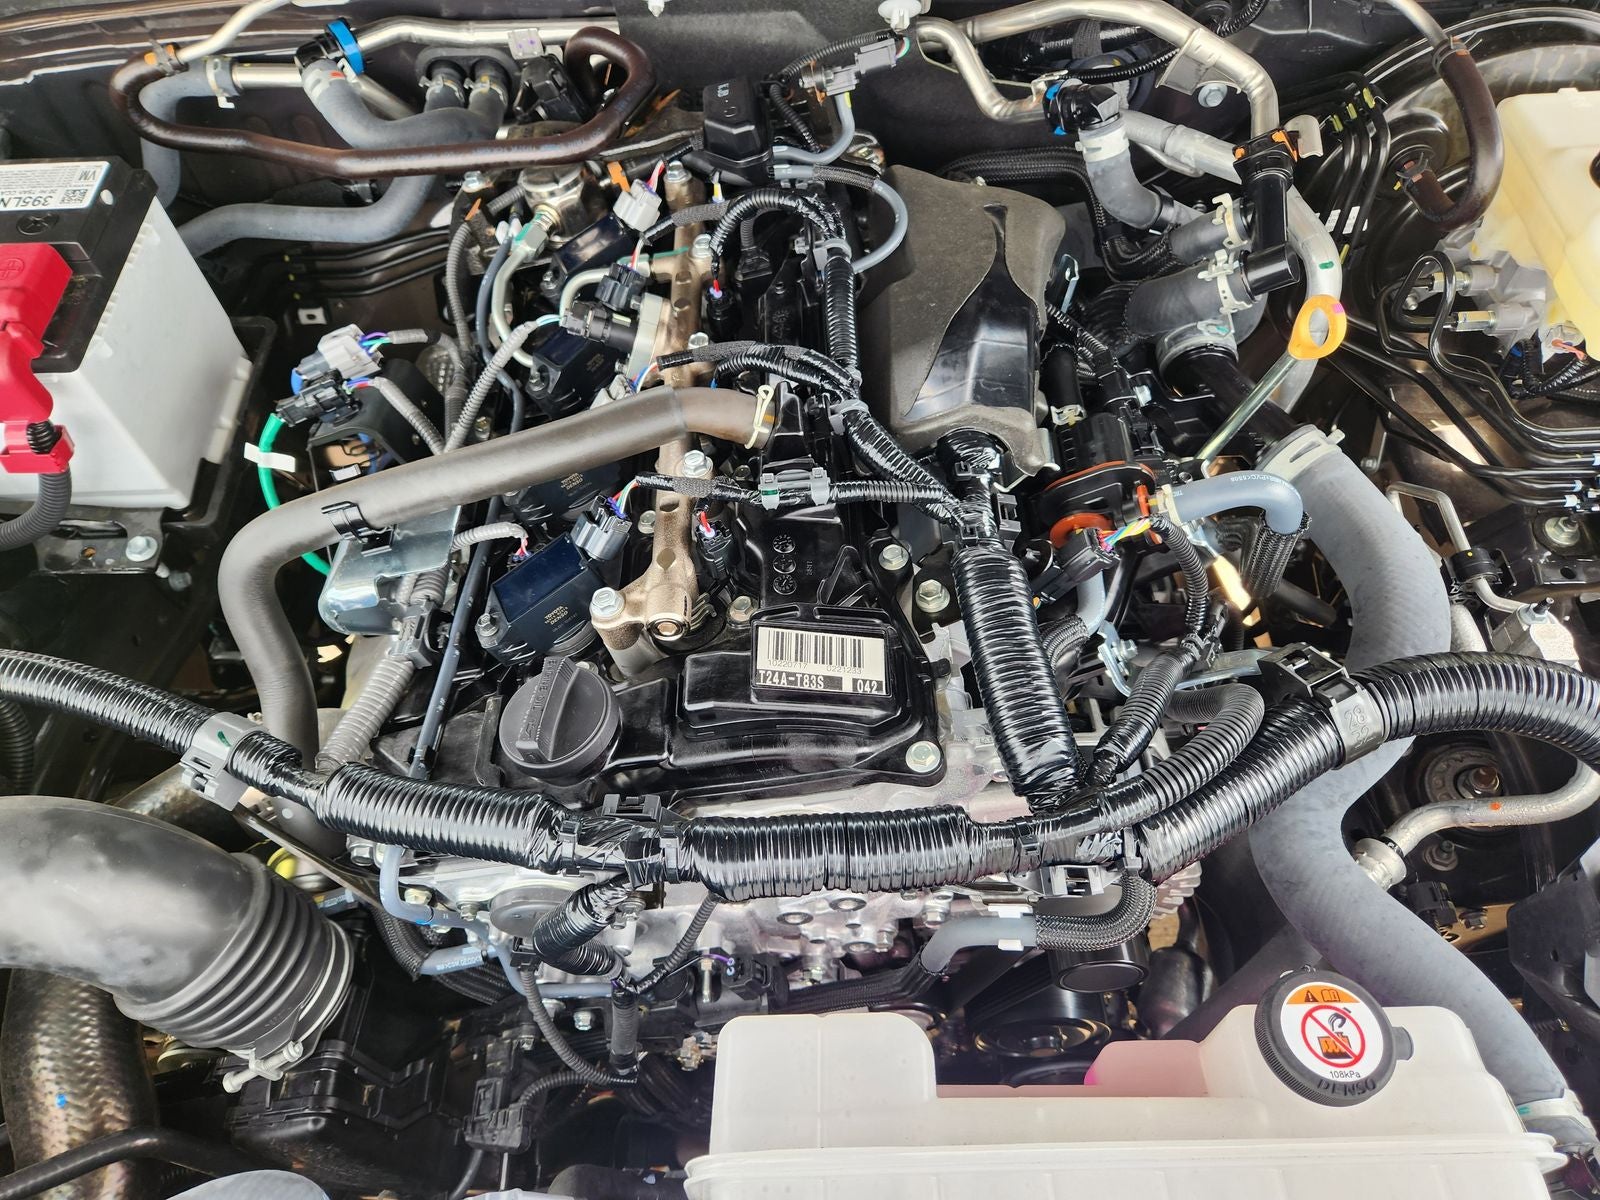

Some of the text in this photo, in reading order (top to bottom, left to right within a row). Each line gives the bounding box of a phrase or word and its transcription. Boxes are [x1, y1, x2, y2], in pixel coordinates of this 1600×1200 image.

[79, 170, 97, 181] VM
[768, 659, 862, 675] 10220717 0221233
[758, 670, 879, 694] T24A-T83S 042
[1330, 1070, 1361, 1080] 108kPa
[1316, 1078, 1377, 1097] DENSO
